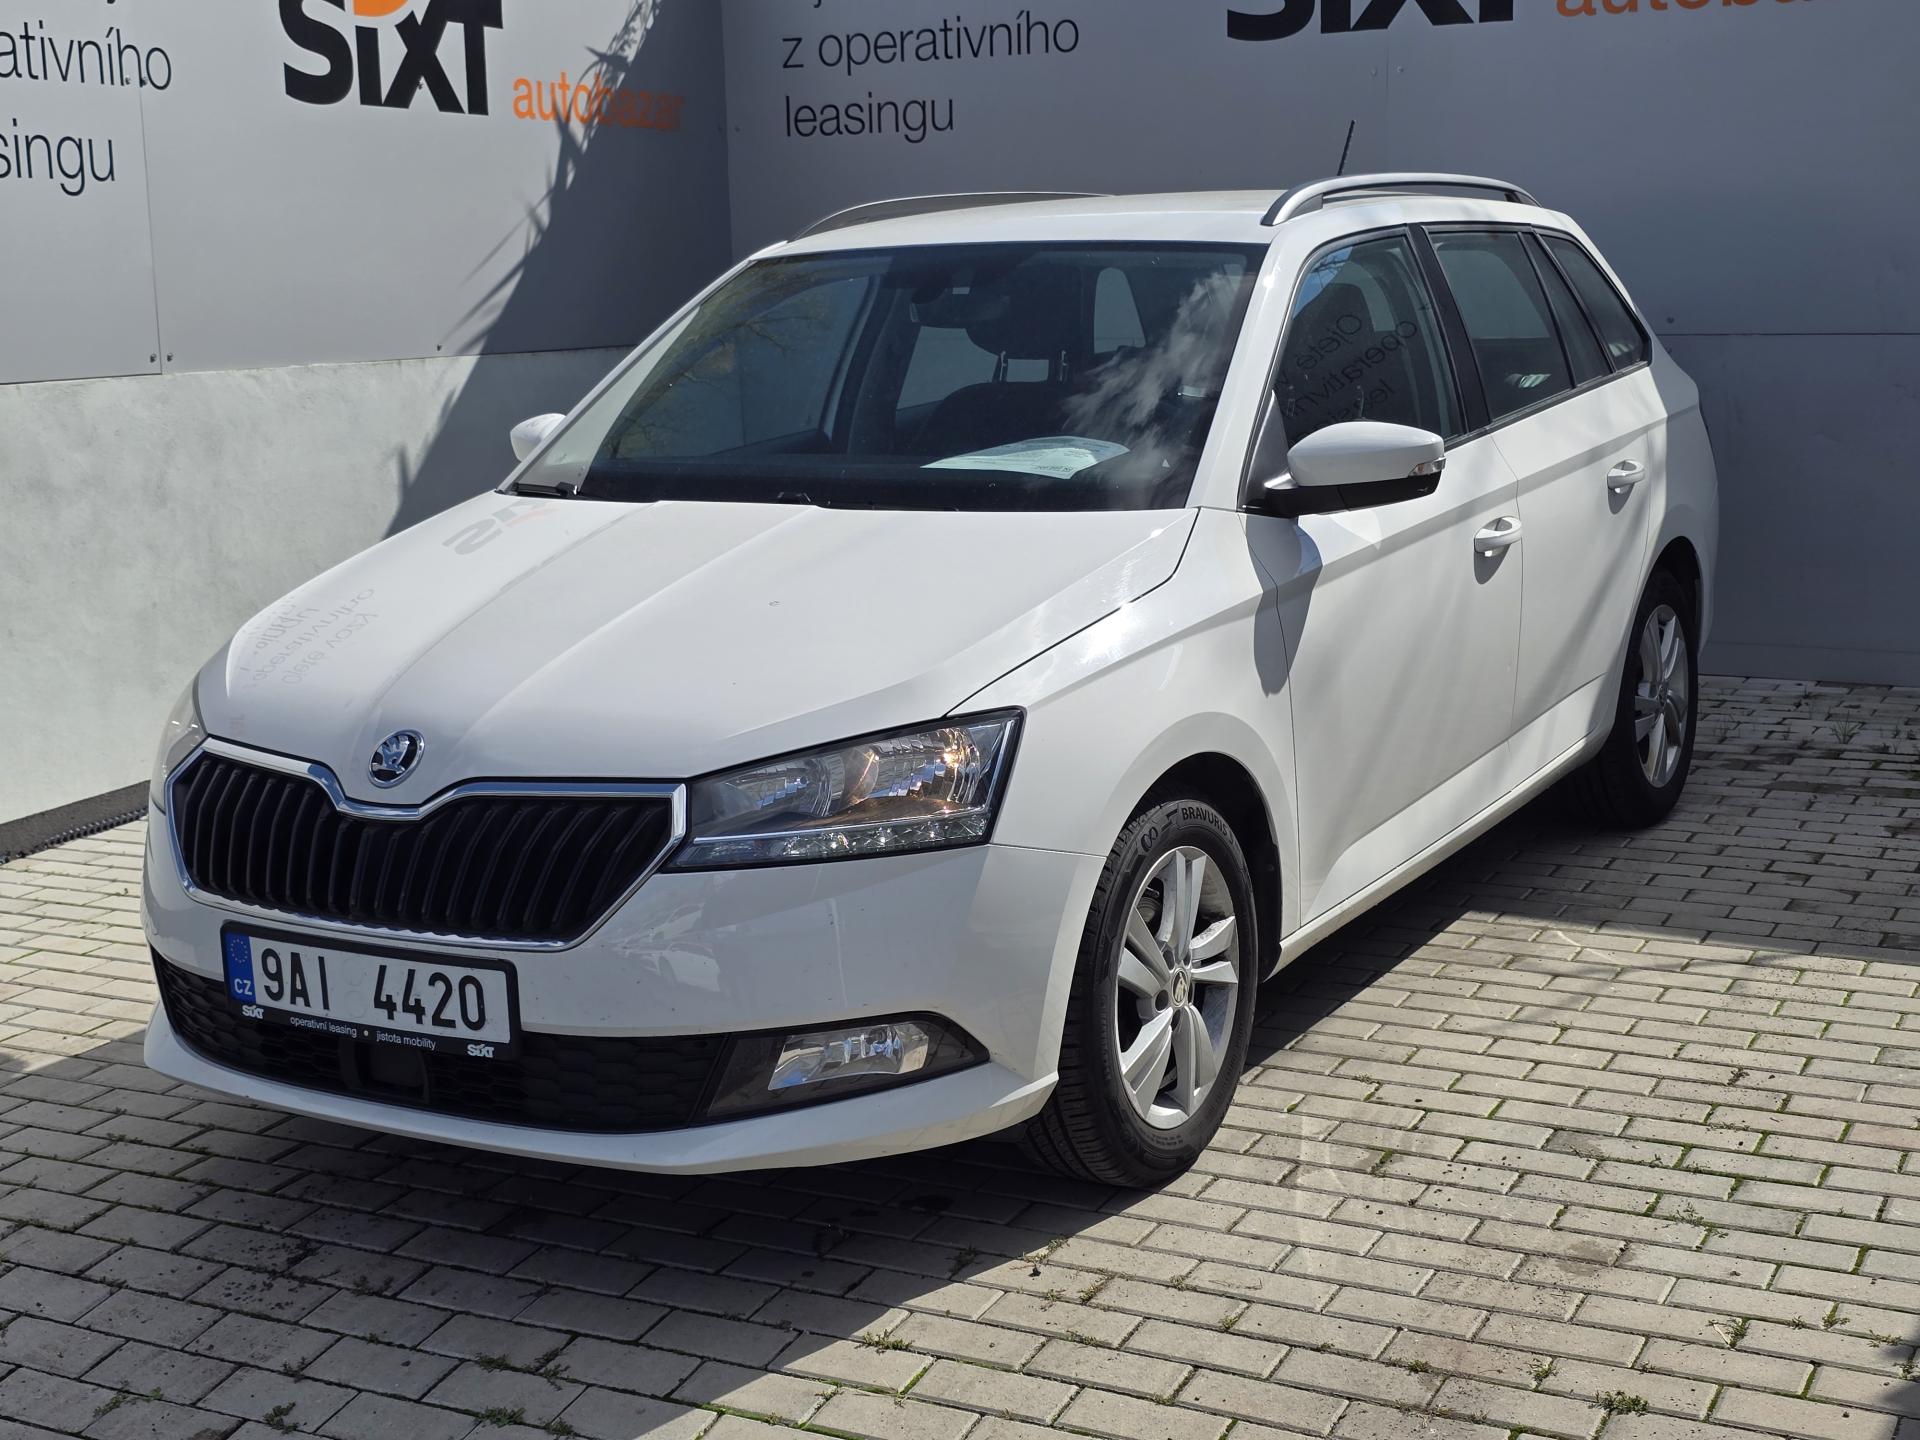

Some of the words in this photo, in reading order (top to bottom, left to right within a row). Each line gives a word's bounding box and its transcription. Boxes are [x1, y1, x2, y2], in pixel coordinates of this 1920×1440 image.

[782, 37, 804, 69] z
[818, 10, 1079, 76] operativního
[785, 92, 954, 143] leasingu
[234, 978, 253, 996] CZ
[373, 964, 487, 1032] 4420
[290, 1016, 327, 1031] operativní
[328, 1020, 357, 1038] leasing
[376, 1031, 402, 1045] jistota
[403, 1035, 437, 1051] mobility
